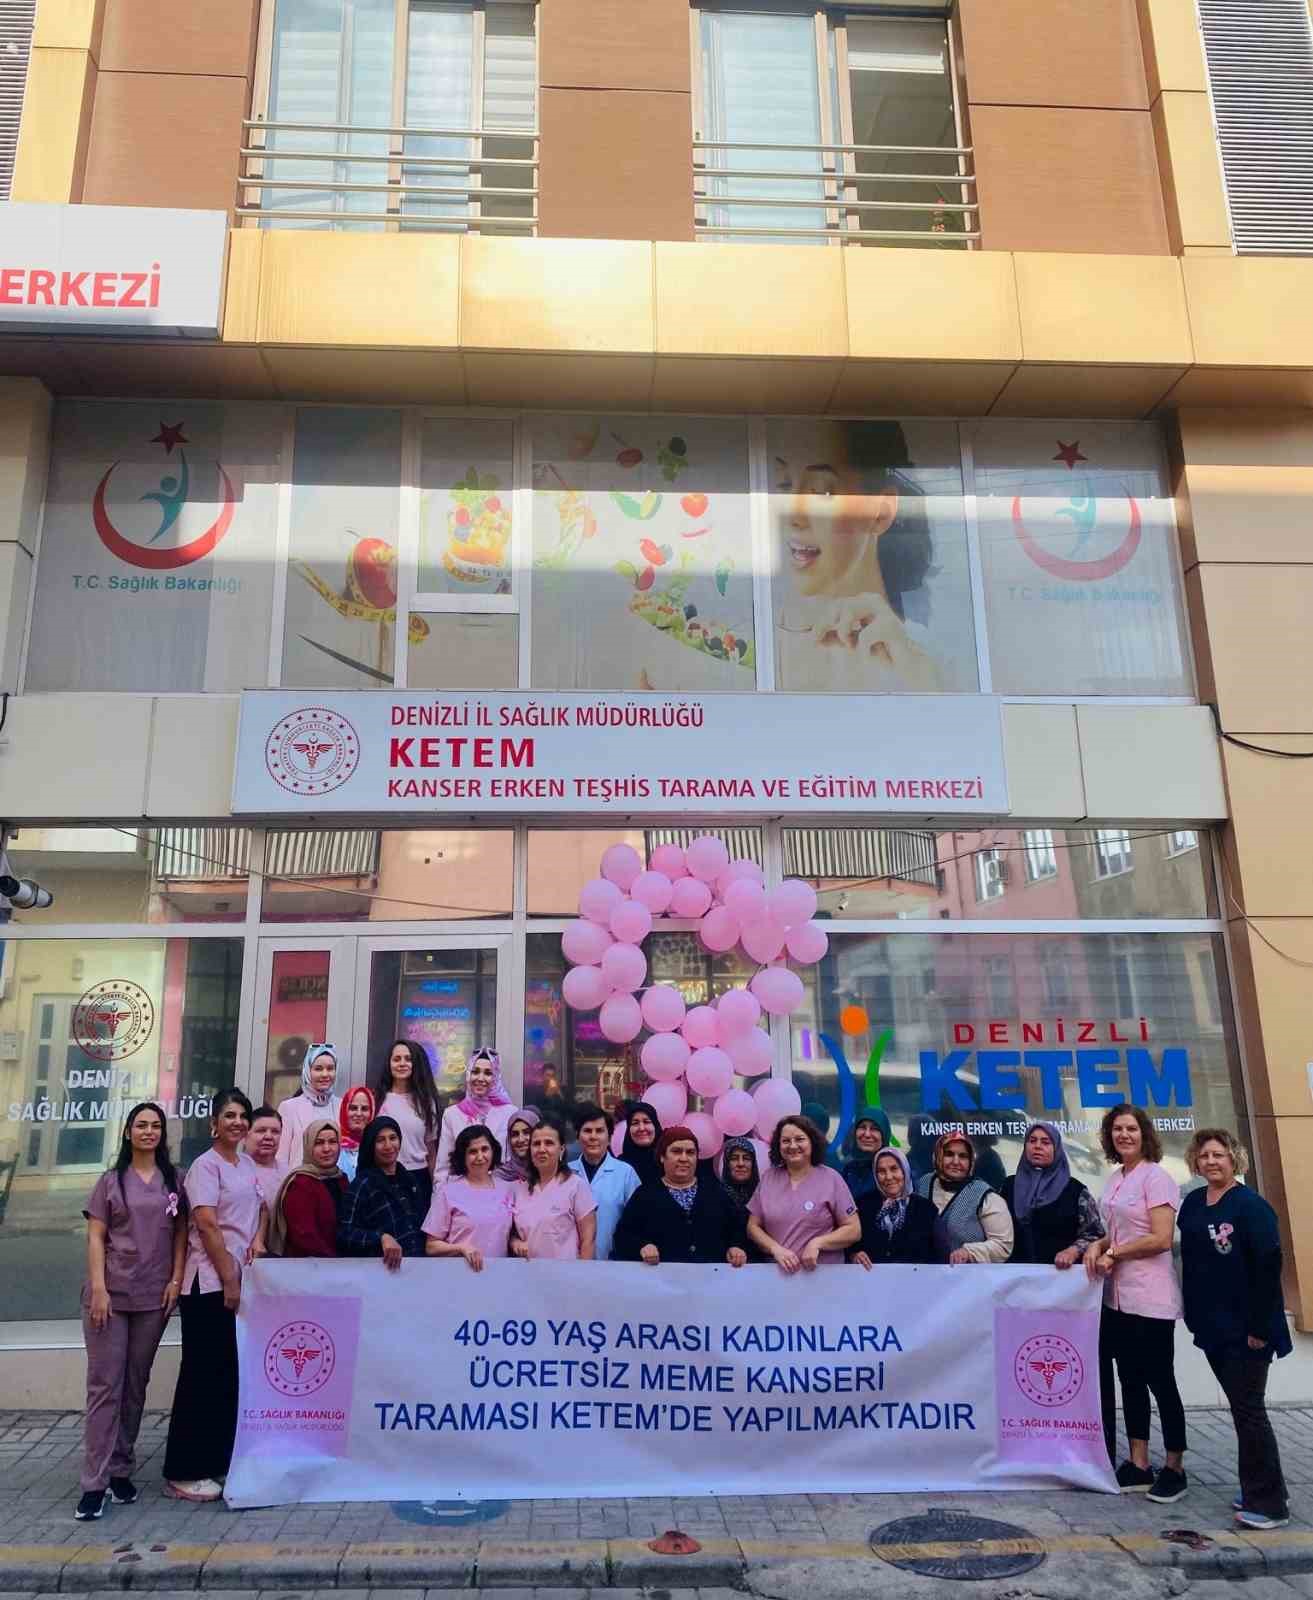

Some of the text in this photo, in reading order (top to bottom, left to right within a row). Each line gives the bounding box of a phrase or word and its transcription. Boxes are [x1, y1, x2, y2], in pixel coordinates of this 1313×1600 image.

[0, 261, 161, 308] ERKEZİ
[72, 576, 101, 589] T.C.
[108, 575, 158, 593] Sağlık
[391, 700, 704, 728] DENİZLİ İL SAĞLIK MÜDÜRLÜĞÜ
[390, 738, 534, 768] KETEM
[387, 775, 984, 803] KANSER ERKEN TEŞHİS TARAMA VE EĞİTİM MERKEZİ
[952, 1017, 1150, 1044] DENİZLİ
[919, 1048, 1193, 1112] KETEM
[8, 1094, 213, 1121] SAĞLIK MÜLÜĞ
[920, 1121, 964, 1136] KANSER
[967, 1121, 1003, 1135] ERKEN
[454, 1320, 903, 1354] 40-69 YAŞ ARASI KADINLARA
[470, 1356, 884, 1393] ÜCRETSİZ MEME KANSERİ
[374, 1403, 538, 1430] TARAMASI
[722, 1402, 976, 1432] YAPILMAKTADIR
